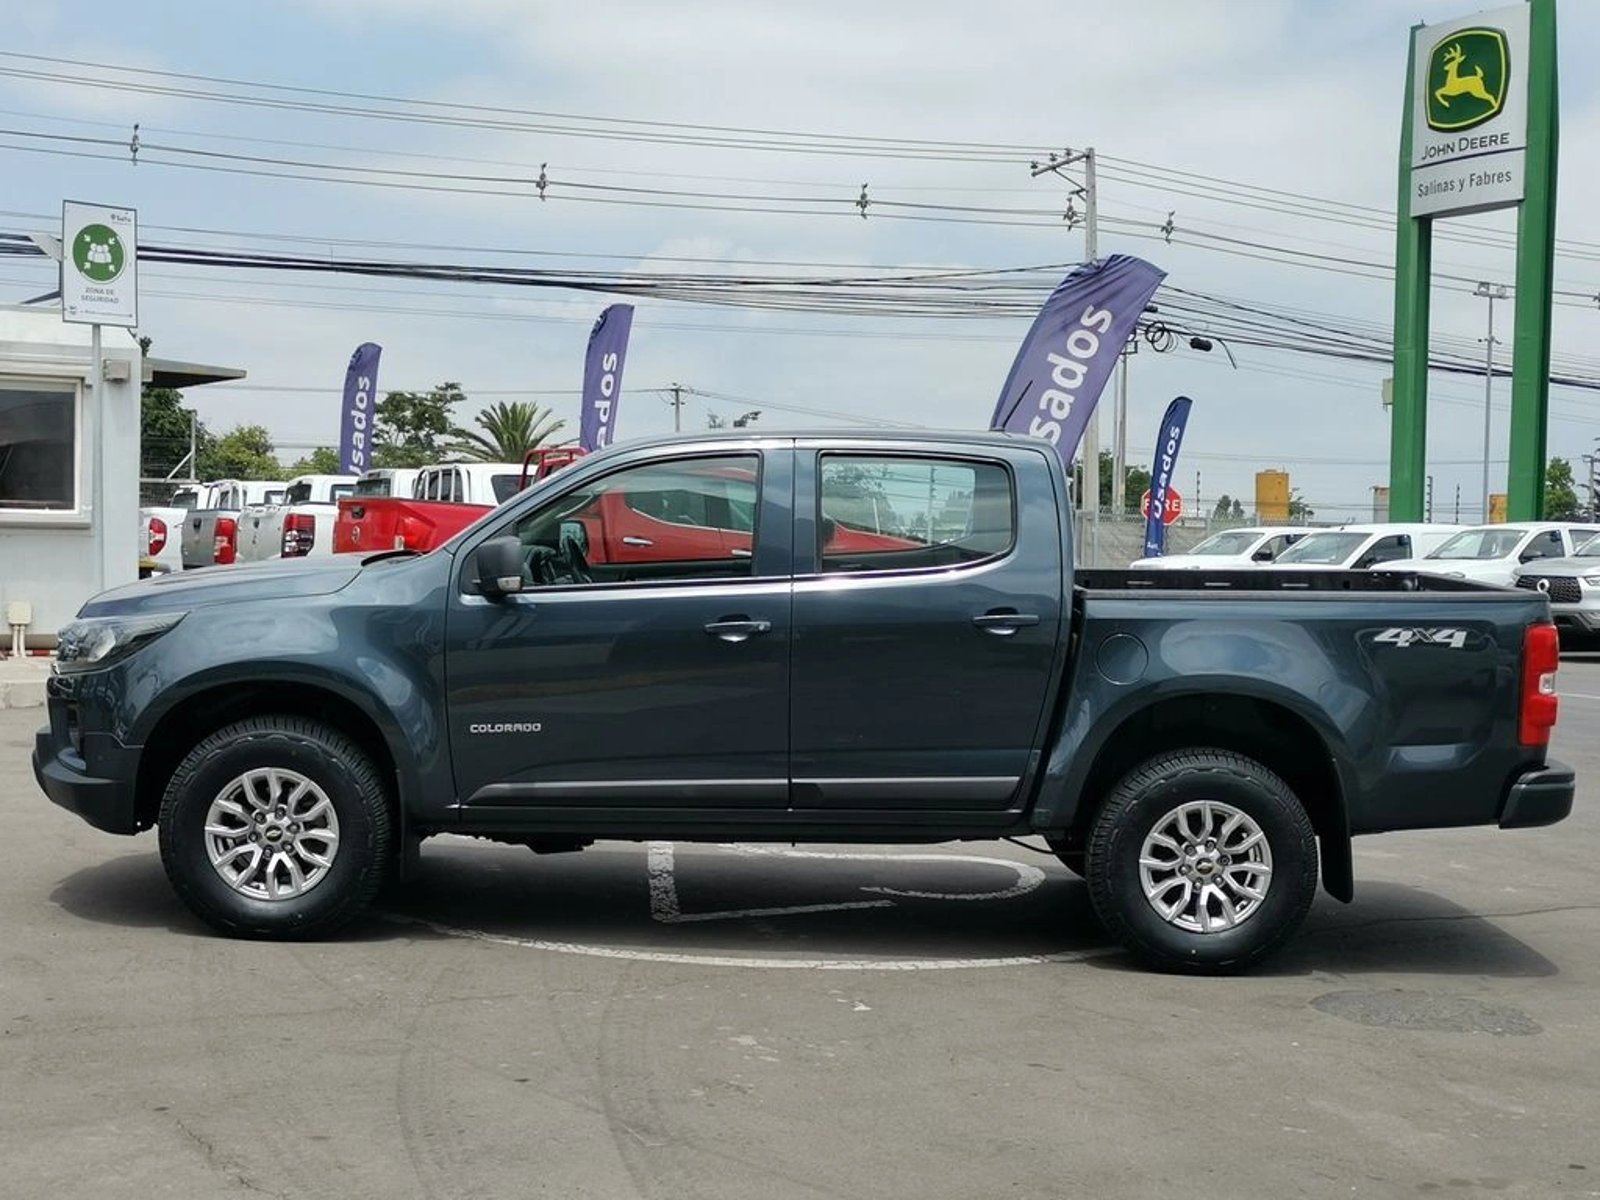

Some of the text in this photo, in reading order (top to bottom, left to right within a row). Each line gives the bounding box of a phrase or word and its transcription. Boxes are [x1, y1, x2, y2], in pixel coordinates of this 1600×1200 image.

[1421, 132, 1510, 160] JOHN DEERE
[1417, 170, 1512, 198] Salinas y Fabres
[1028, 304, 1113, 446] sados
[469, 722, 542, 734] COLORADO
